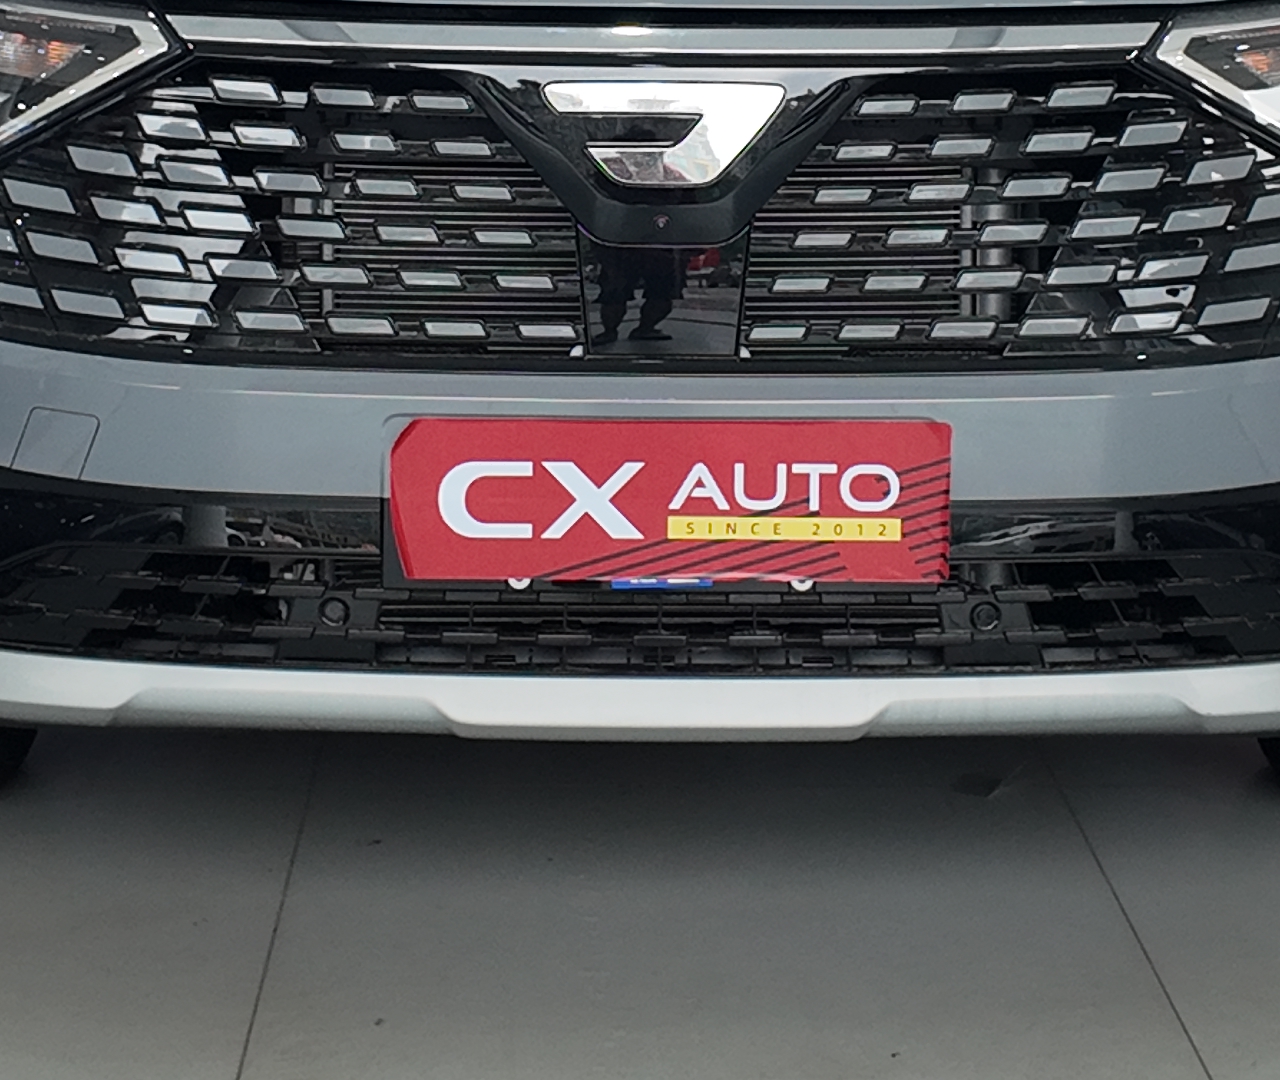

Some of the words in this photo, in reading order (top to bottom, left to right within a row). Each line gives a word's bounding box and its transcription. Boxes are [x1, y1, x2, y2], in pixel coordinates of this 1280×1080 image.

[437, 460, 646, 539] CX
[667, 462, 900, 513] AUTO
[685, 521, 783, 536] SINCE
[811, 521, 889, 537] 2012
